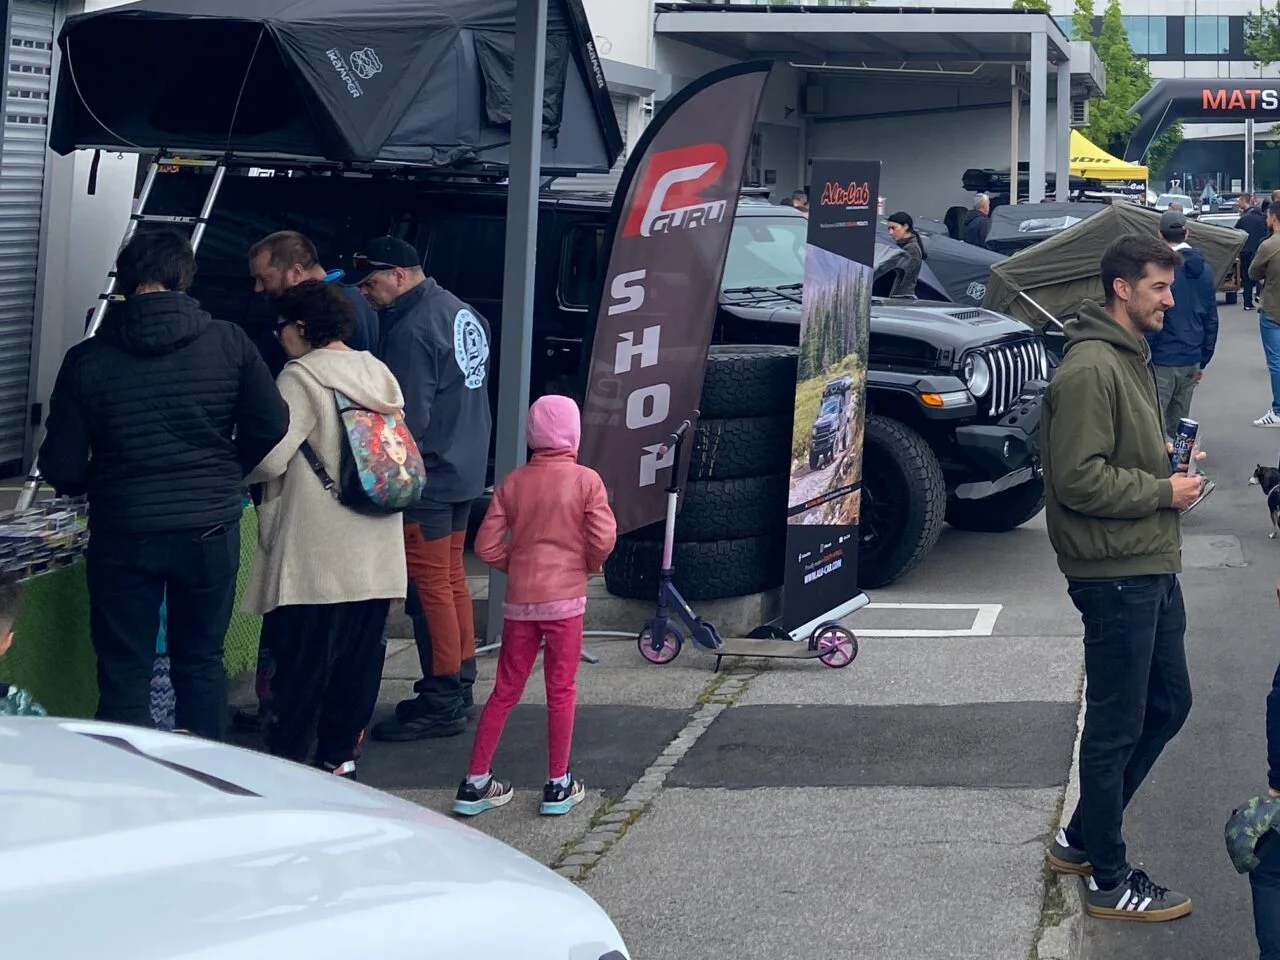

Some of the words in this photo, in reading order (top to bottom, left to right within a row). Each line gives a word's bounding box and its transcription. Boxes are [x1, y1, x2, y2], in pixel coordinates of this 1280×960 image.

[821, 181, 870, 206] Alu-Cab
[650, 199, 727, 234] GURU
[1175, 441, 1188, 450] ola
